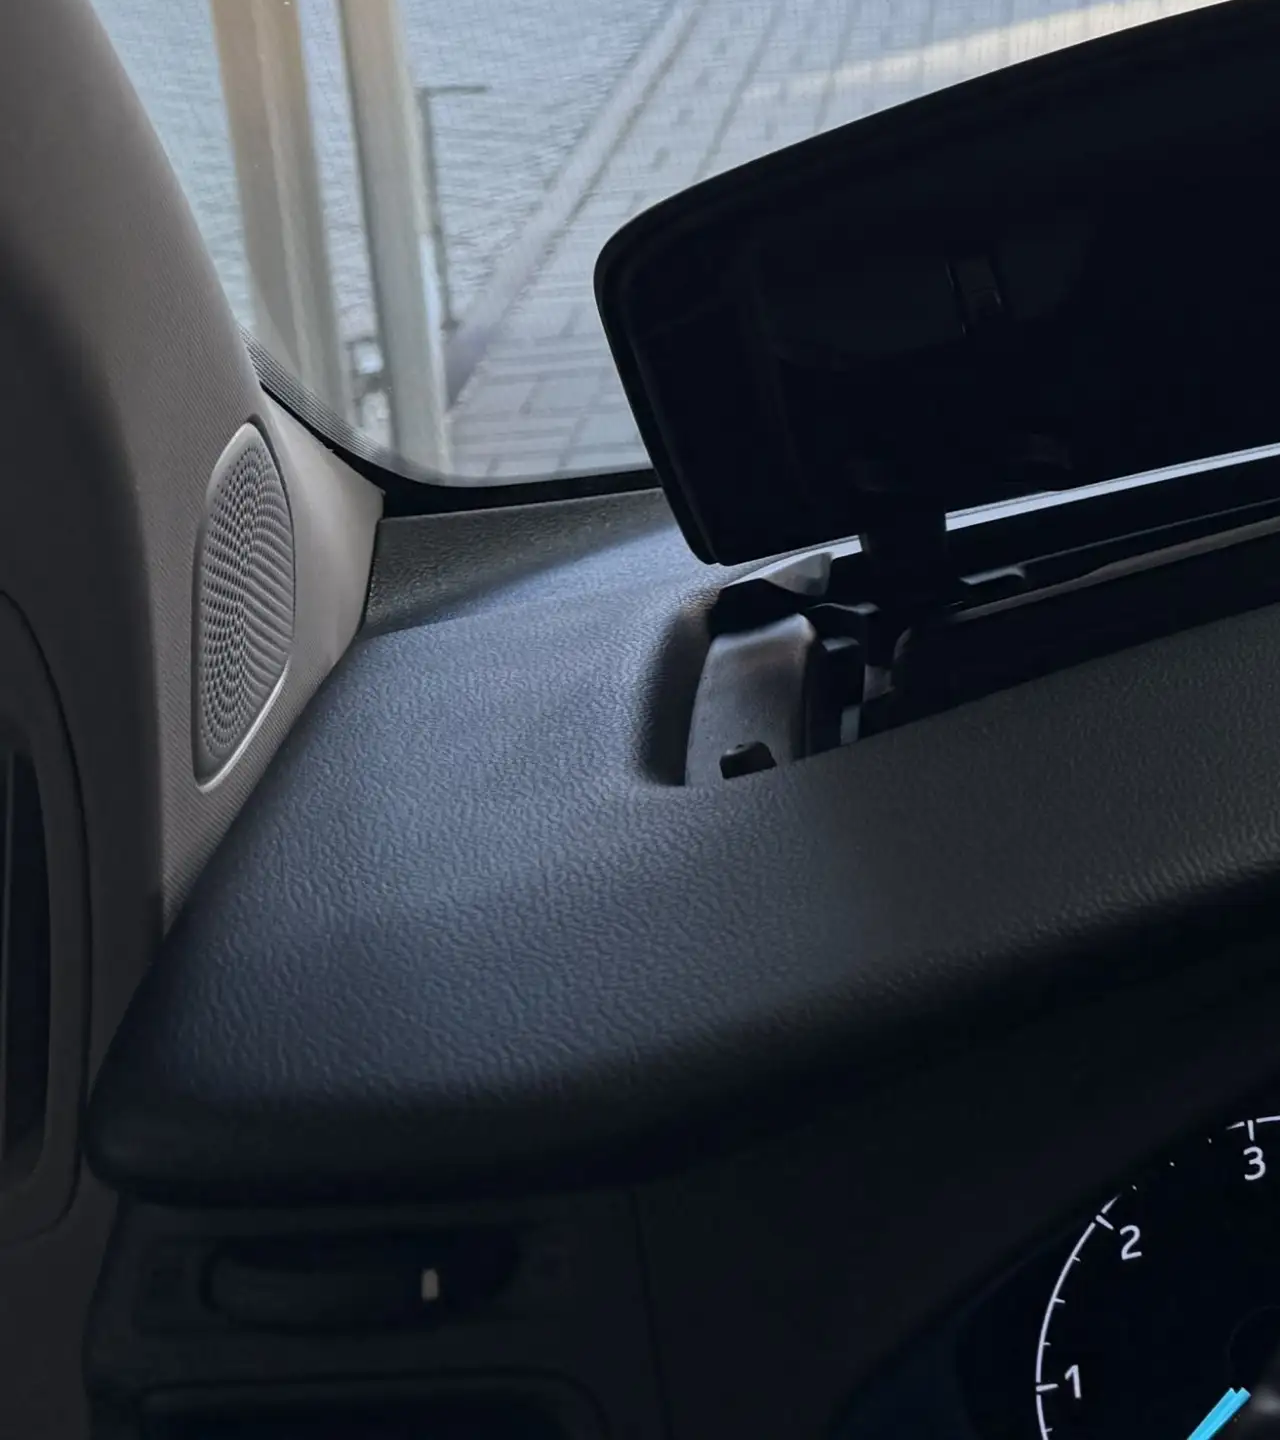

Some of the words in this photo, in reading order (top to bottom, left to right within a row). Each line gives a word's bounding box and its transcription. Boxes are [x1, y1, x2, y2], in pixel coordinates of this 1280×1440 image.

[1243, 1146, 1267, 1181] 3
[1119, 1224, 1142, 1261] 2
[1064, 1364, 1082, 1399] 1
